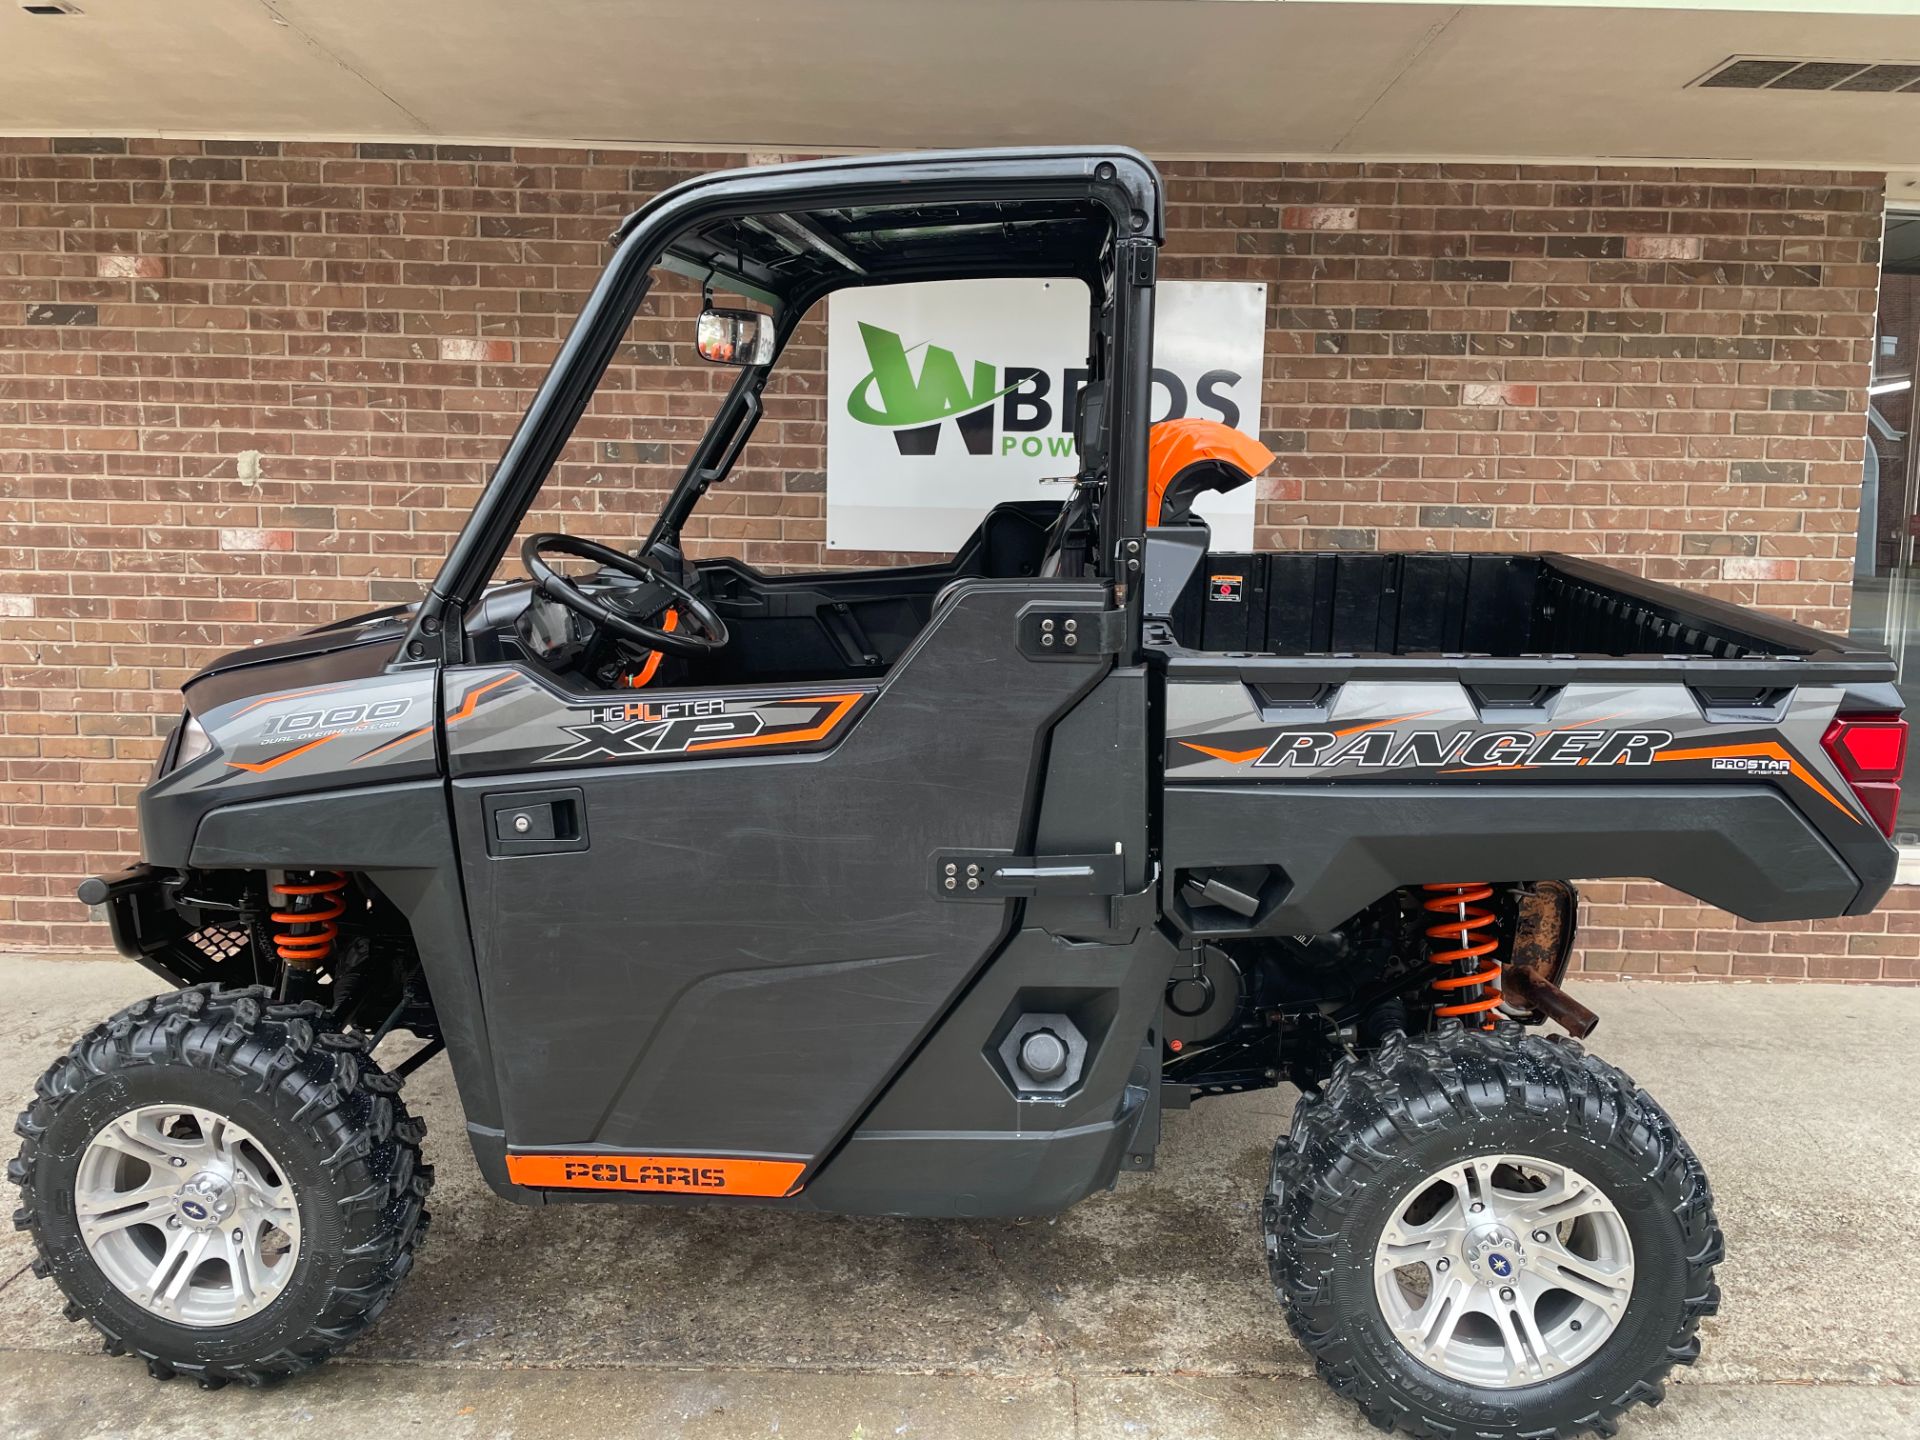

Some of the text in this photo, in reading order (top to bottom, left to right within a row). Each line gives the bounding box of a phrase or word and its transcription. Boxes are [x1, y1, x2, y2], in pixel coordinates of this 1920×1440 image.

[264, 697, 413, 736] 1000
[591, 699, 725, 723] HIGHLIFTER
[260, 721, 400, 746] DUAL OVERHEAD CAM
[530, 711, 765, 763] XP
[1252, 730, 1673, 767] RANGER
[1712, 759, 1790, 770] PROSTAR
[565, 1163, 726, 1187] POLARIS
